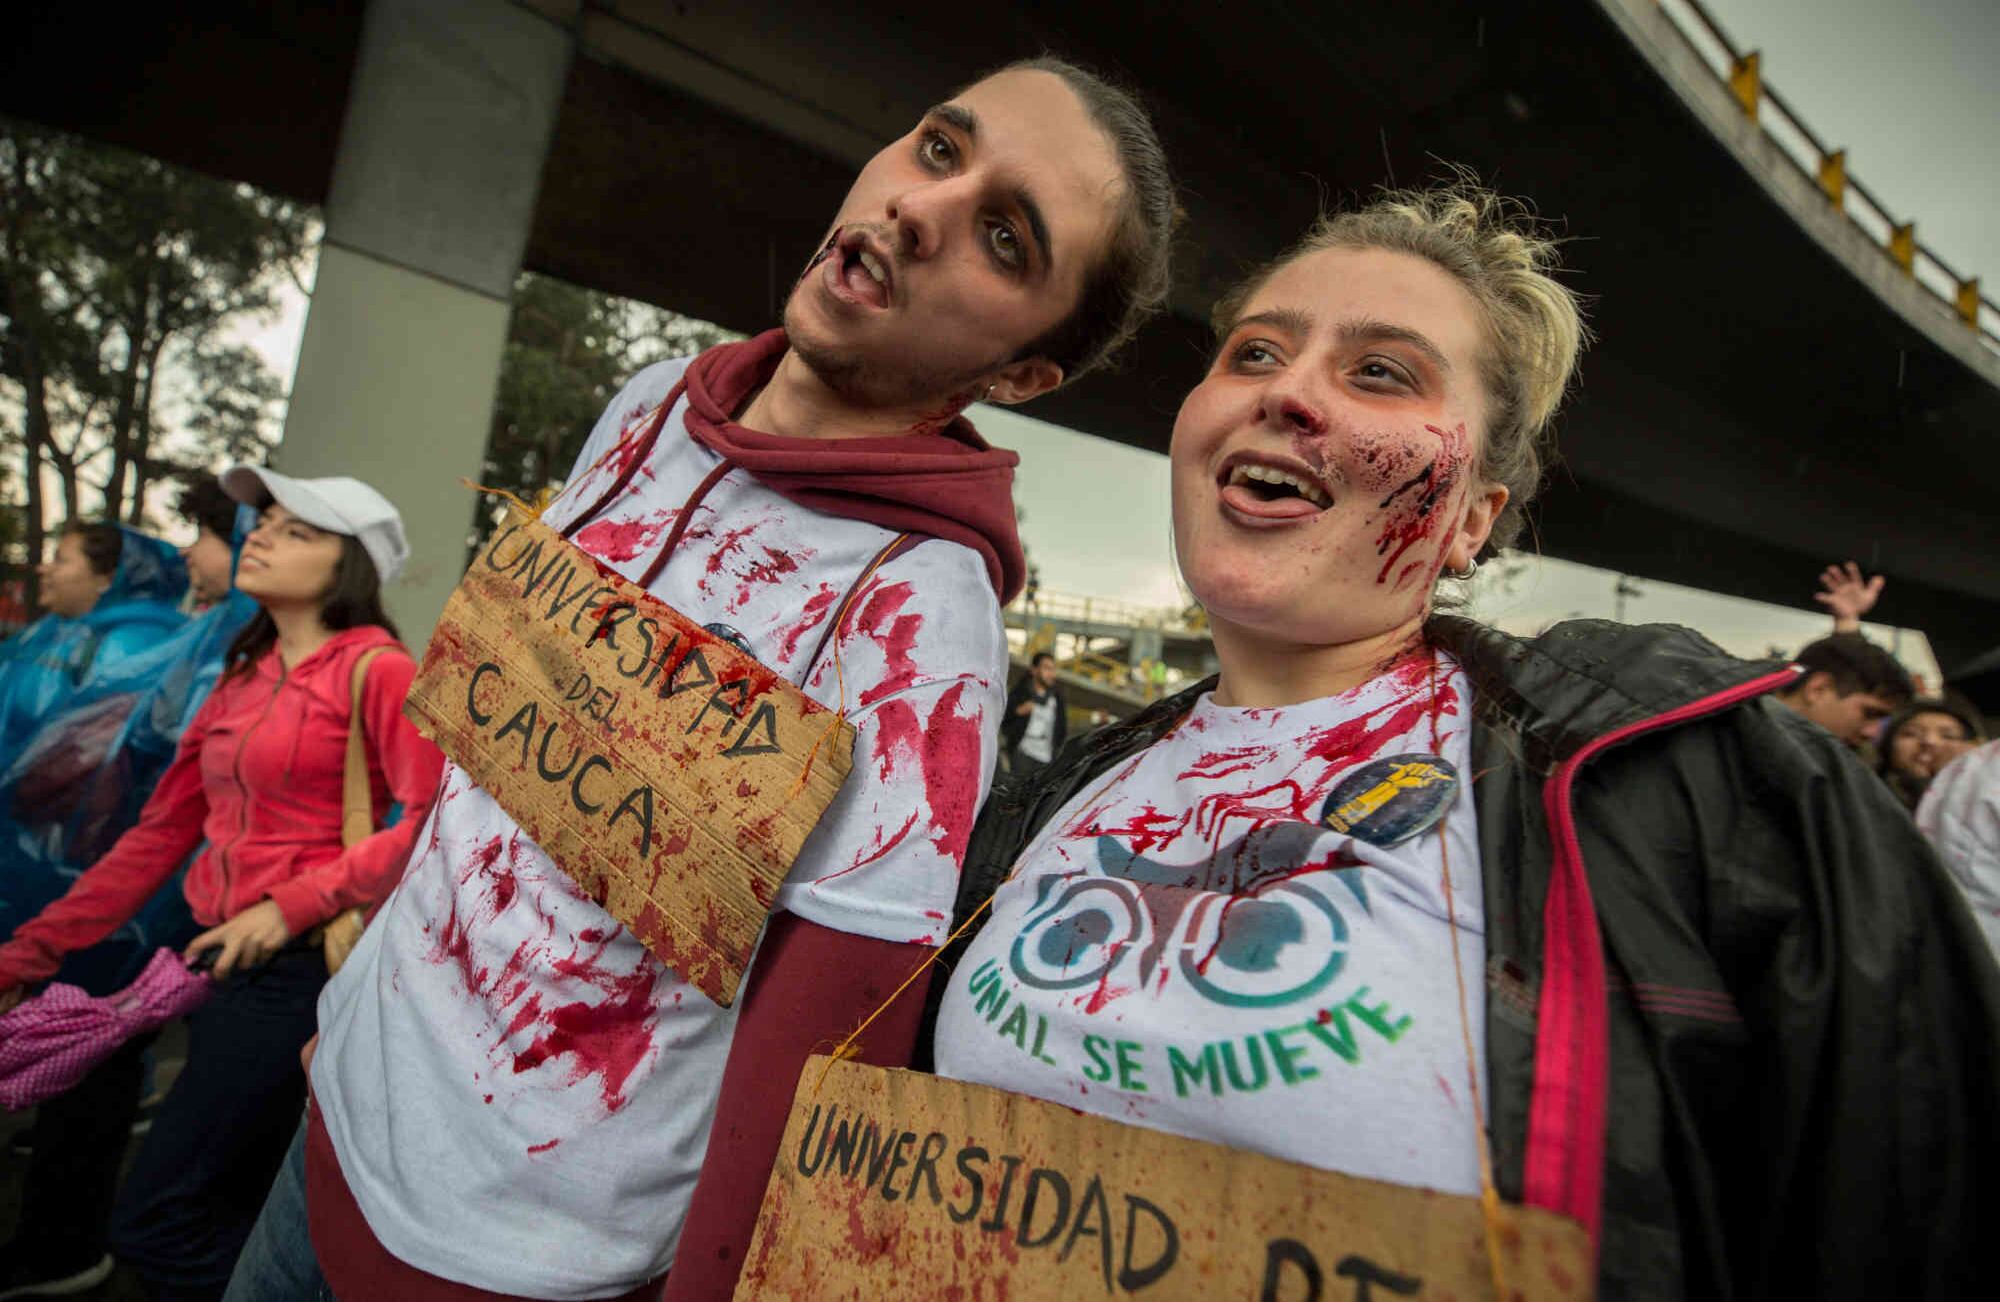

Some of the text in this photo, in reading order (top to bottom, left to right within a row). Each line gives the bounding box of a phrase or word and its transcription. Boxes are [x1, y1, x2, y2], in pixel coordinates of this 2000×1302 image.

[485, 525, 782, 757] UNIVERSIDAD
[564, 671, 619, 733] DEL
[467, 662, 655, 859] CAUCA
[968, 957, 1414, 1098] UNAL SE MUEVE
[797, 1103, 1180, 1293] UNIVERSIDAD
